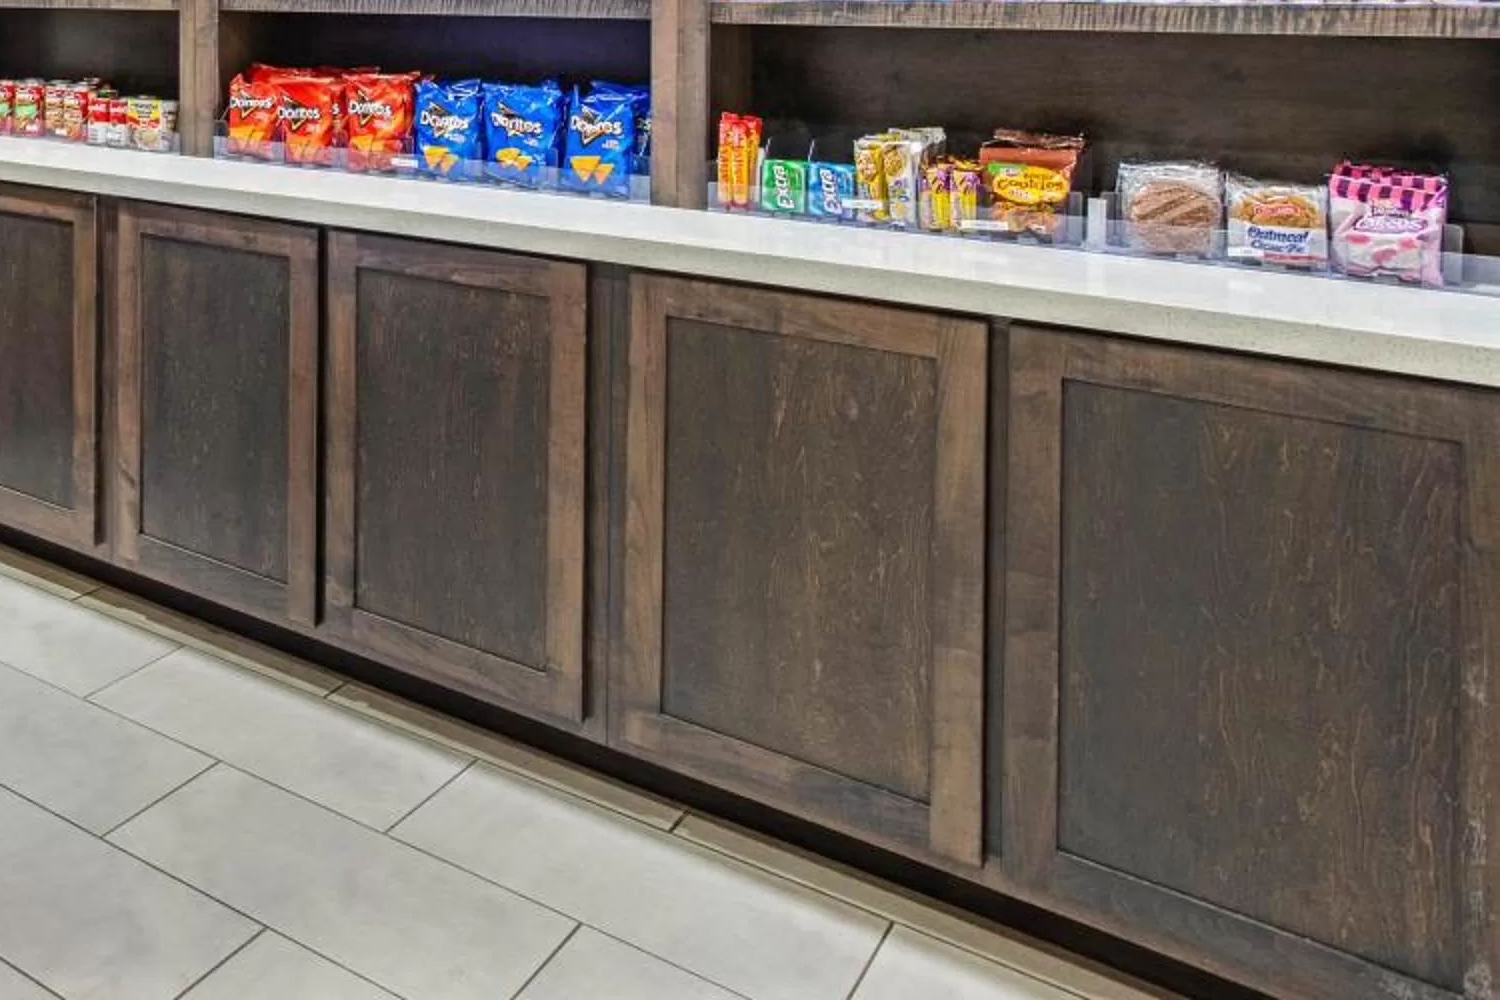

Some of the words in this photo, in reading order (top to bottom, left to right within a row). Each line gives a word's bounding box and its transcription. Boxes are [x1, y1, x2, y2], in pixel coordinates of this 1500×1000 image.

[229, 95, 274, 110] Doritos
[349, 101, 392, 117] Doritos
[278, 106, 320, 120] Doritos
[419, 111, 470, 131] Doritos
[491, 112, 542, 134] Doritos
[570, 115, 623, 136] Doritos
[772, 164, 795, 210] Extra
[821, 169, 843, 214] Extra
[1246, 226, 1309, 244] Oatmeal
